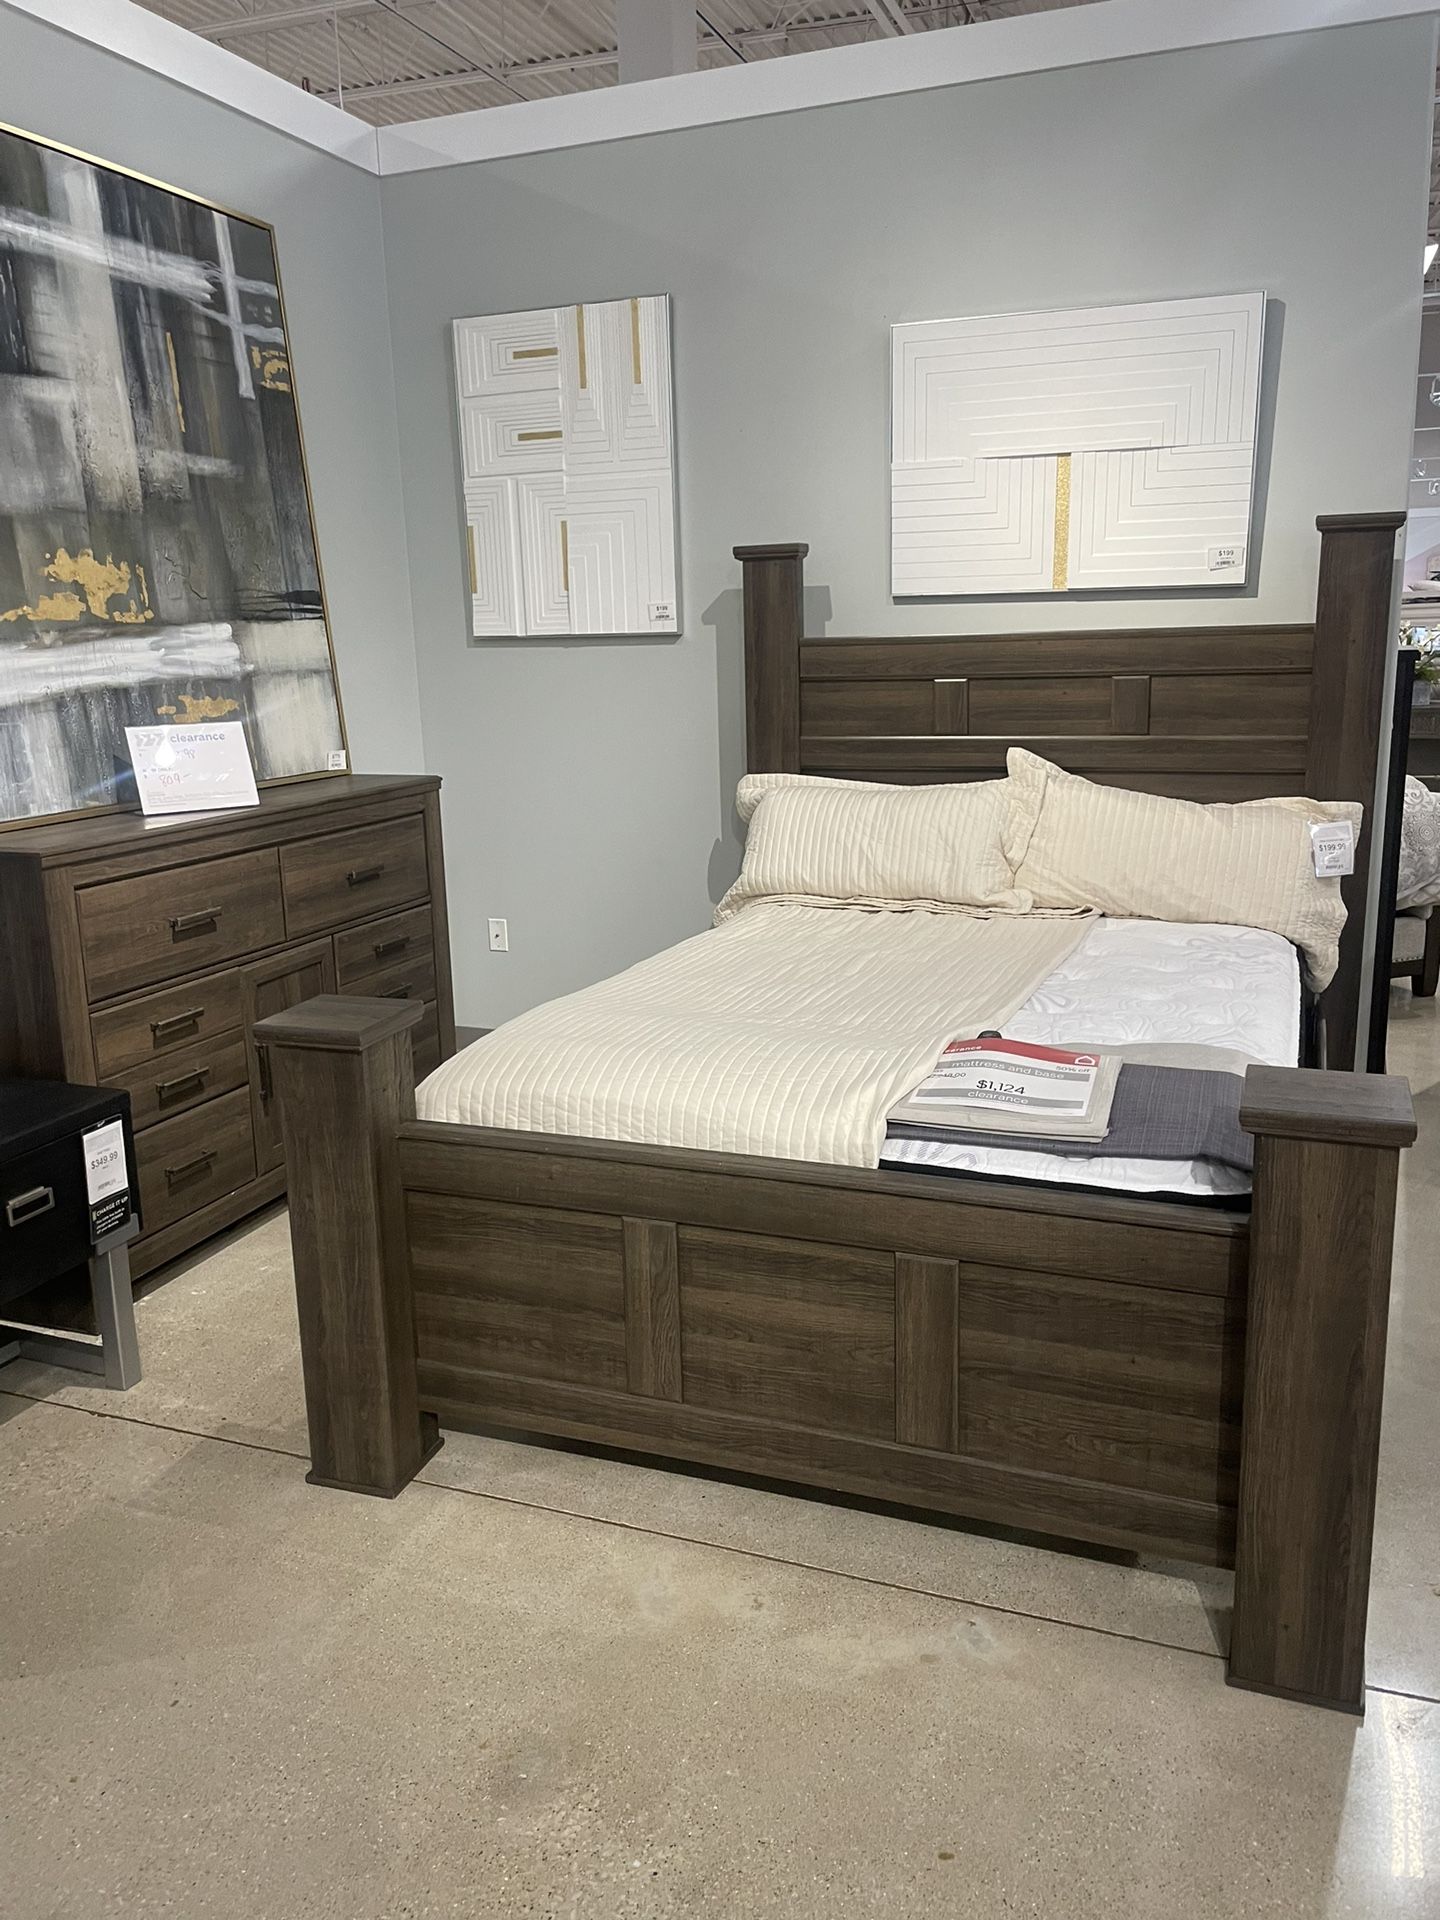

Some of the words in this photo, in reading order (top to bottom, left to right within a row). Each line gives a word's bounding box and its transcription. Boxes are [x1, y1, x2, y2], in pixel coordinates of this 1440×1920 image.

[170, 733, 225, 743] clearance
[951, 1060, 1004, 1073] mattress
[1007, 1064, 1031, 1076] and
[1034, 1068, 1065, 1079] base
[976, 1079, 1026, 1094] $1,124
[967, 1090, 1029, 1105] clearance
[91, 1151, 118, 1170] $349.99
